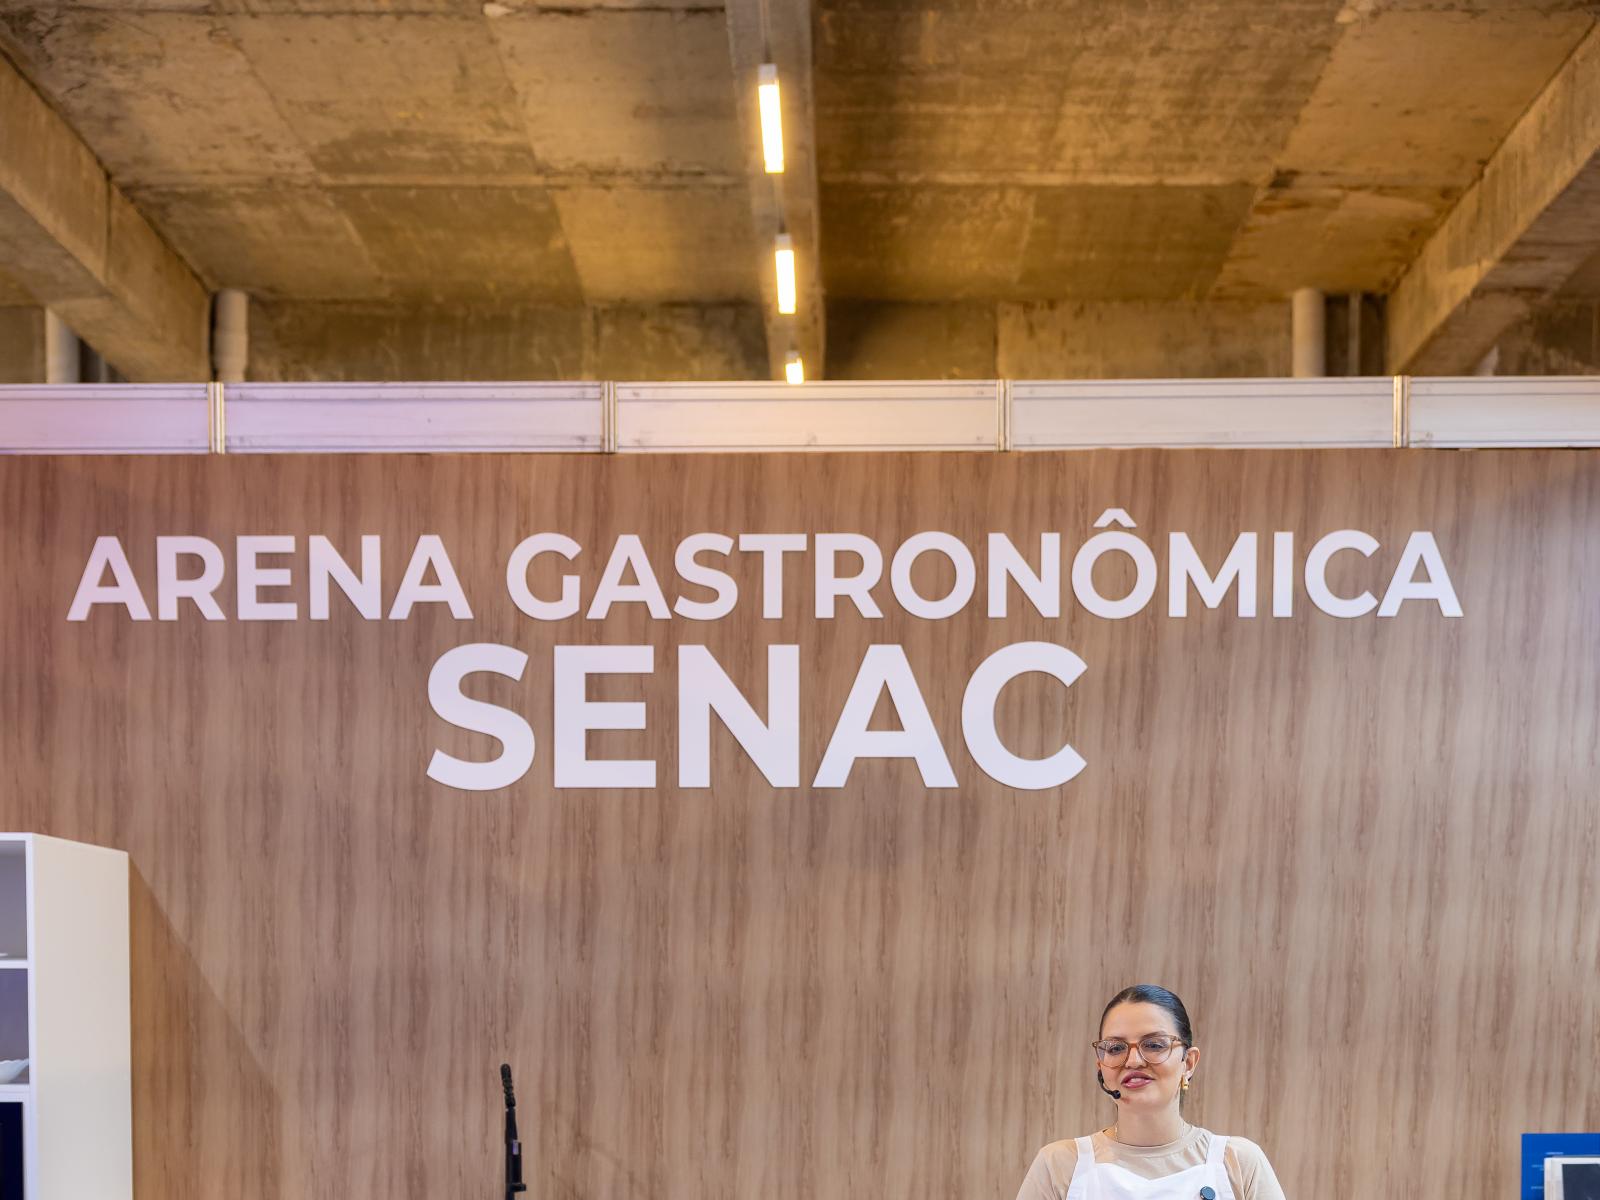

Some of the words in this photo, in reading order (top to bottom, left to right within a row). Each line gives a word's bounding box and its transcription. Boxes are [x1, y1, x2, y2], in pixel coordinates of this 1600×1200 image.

[66, 534, 474, 622] ARENA
[506, 507, 1464, 622] GASTRONÔMICA
[425, 641, 1088, 791] SENAC
